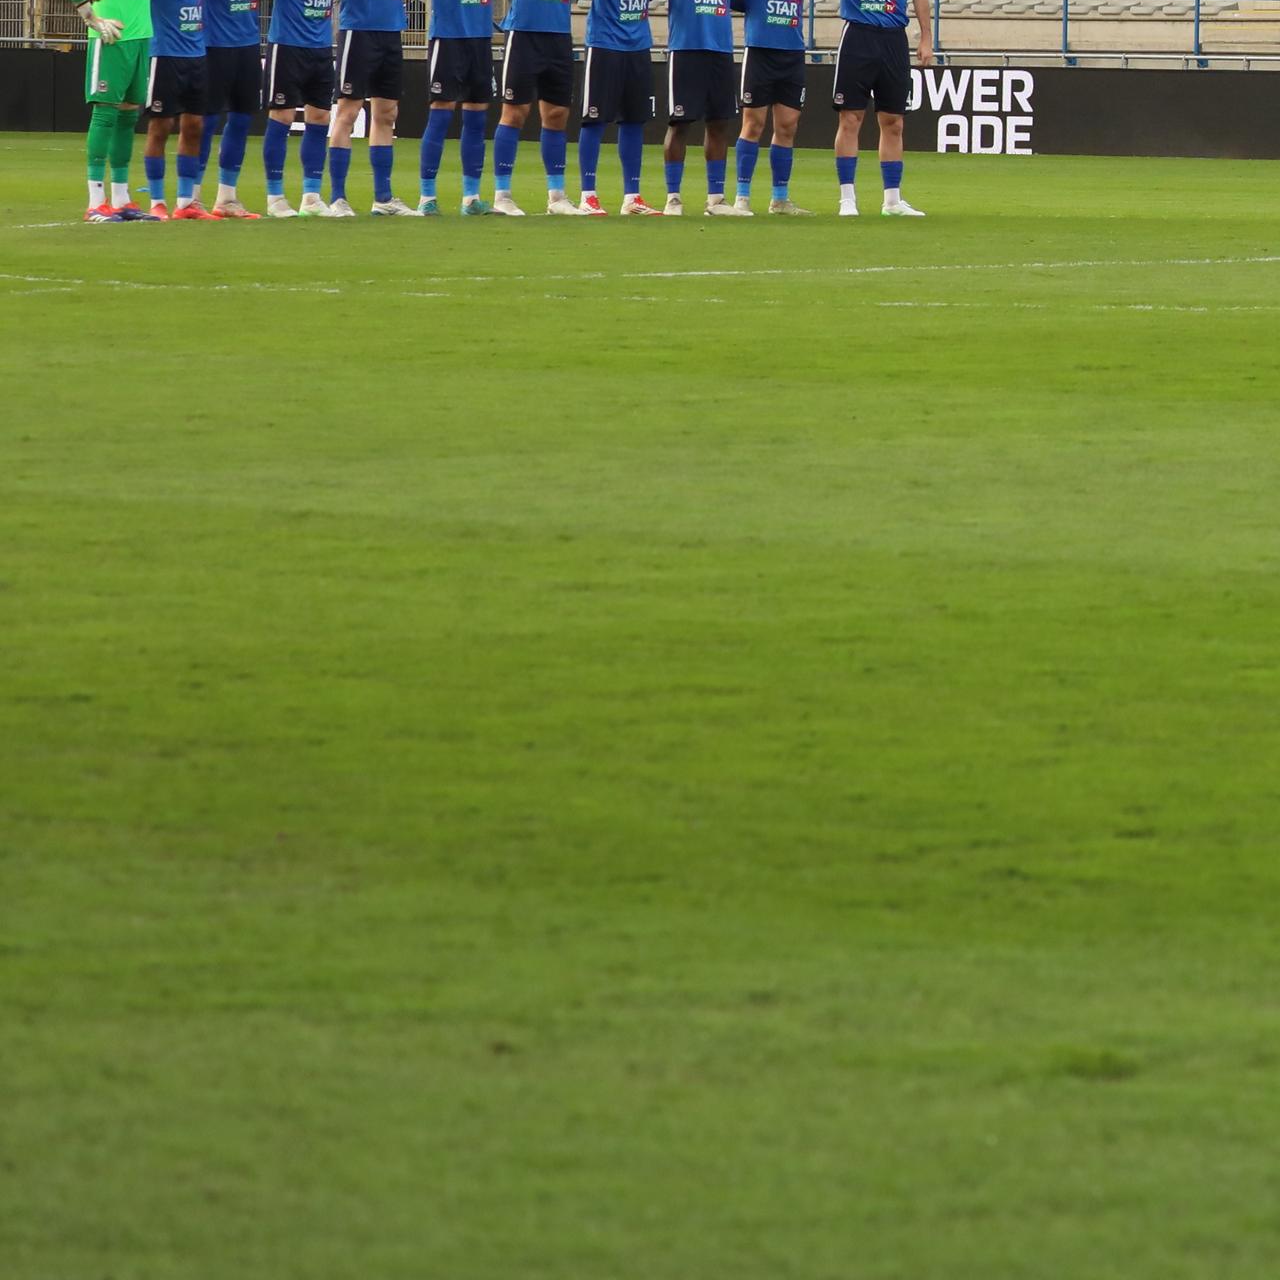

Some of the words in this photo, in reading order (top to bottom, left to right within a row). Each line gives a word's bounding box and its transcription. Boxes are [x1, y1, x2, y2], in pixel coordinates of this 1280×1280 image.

[766, 0, 798, 16] STAR
[861, 3, 884, 11] SPORT
[619, 13, 641, 21] SPORT
[767, 16, 790, 25] SPORT
[936, 114, 1033, 155] ADE
